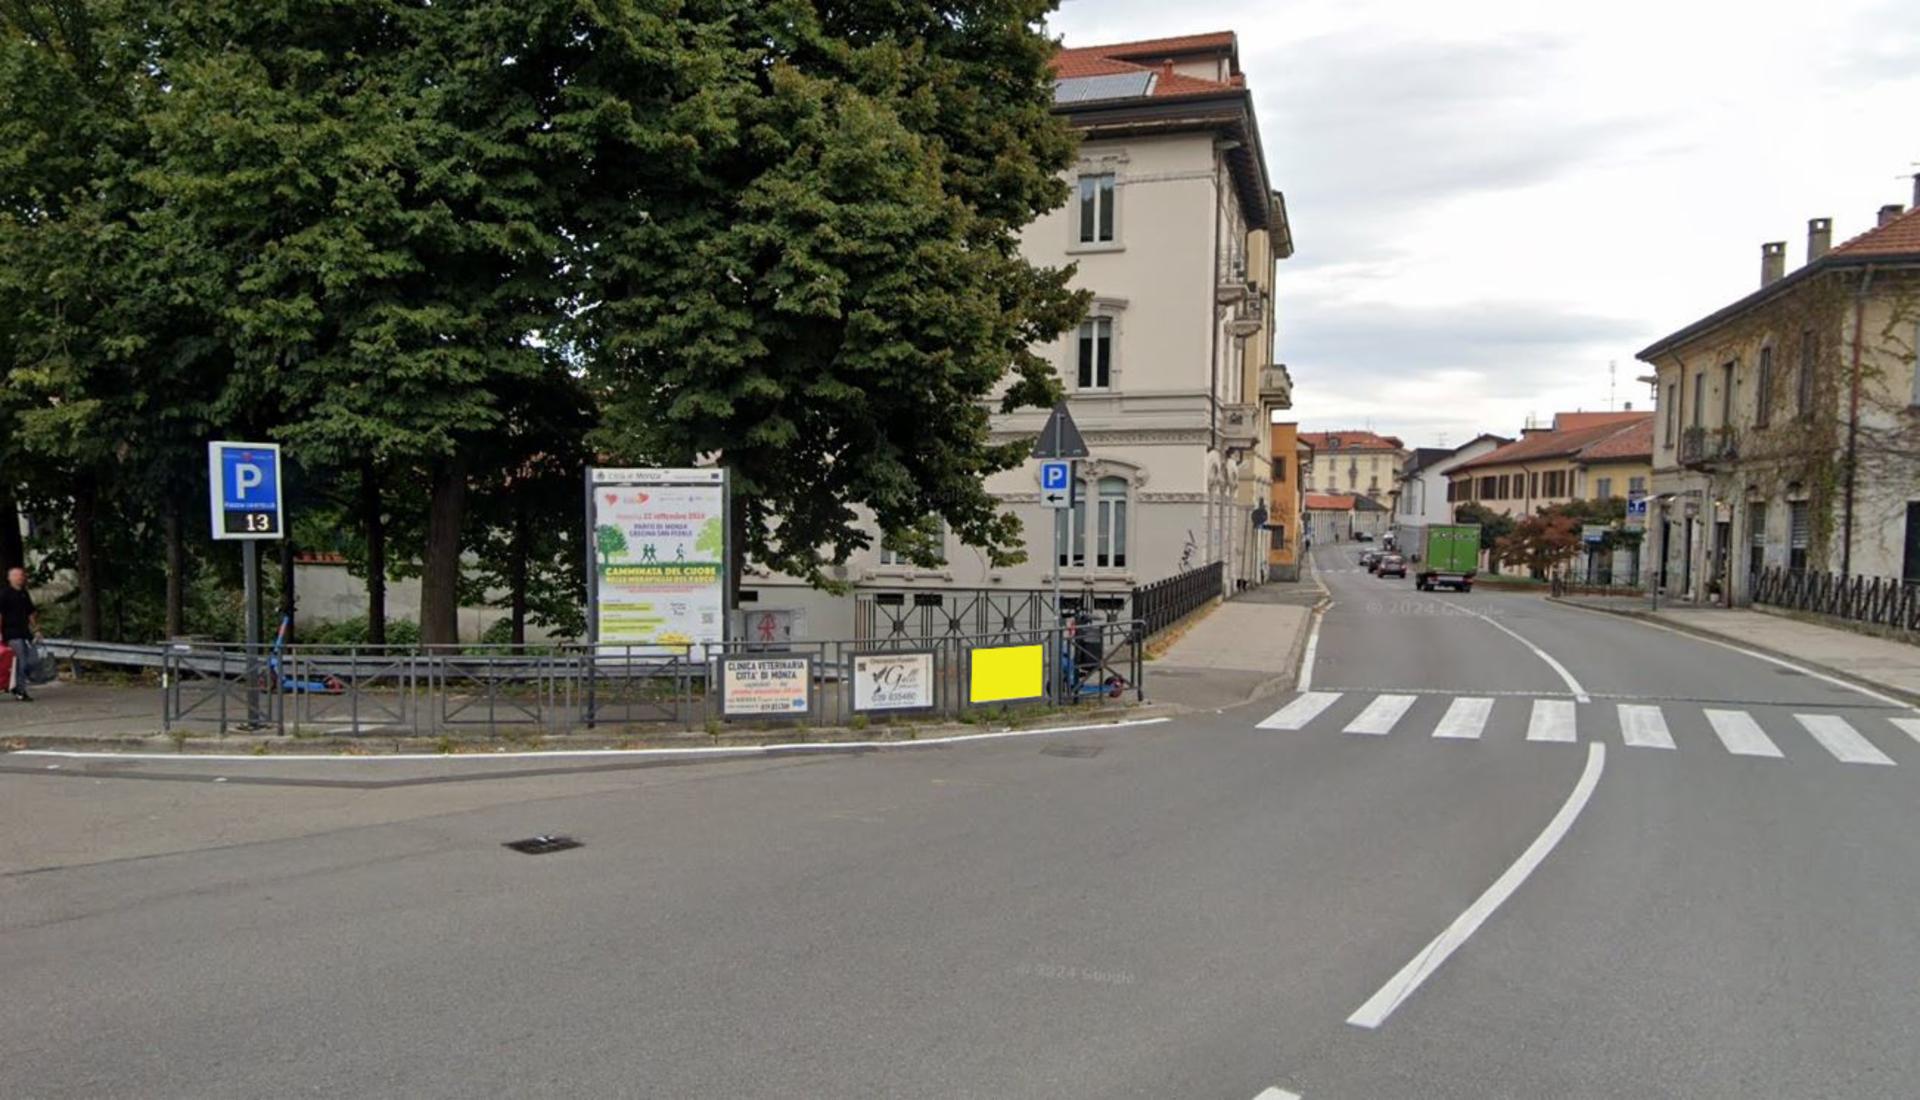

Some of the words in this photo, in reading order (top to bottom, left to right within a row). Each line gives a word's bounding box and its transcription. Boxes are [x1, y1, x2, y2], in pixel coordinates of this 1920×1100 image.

[235, 463, 262, 499] P
[1048, 467, 1063, 487] P
[246, 513, 269, 531] 13
[605, 567, 663, 576] CAMMINATA
[665, 567, 682, 575] DEL
[683, 567, 716, 575] CUORE
[728, 662, 757, 671] CLINICA
[758, 660, 805, 671] VETERINARIA
[761, 671, 769, 679] DI
[771, 670, 797, 679] MONZA
